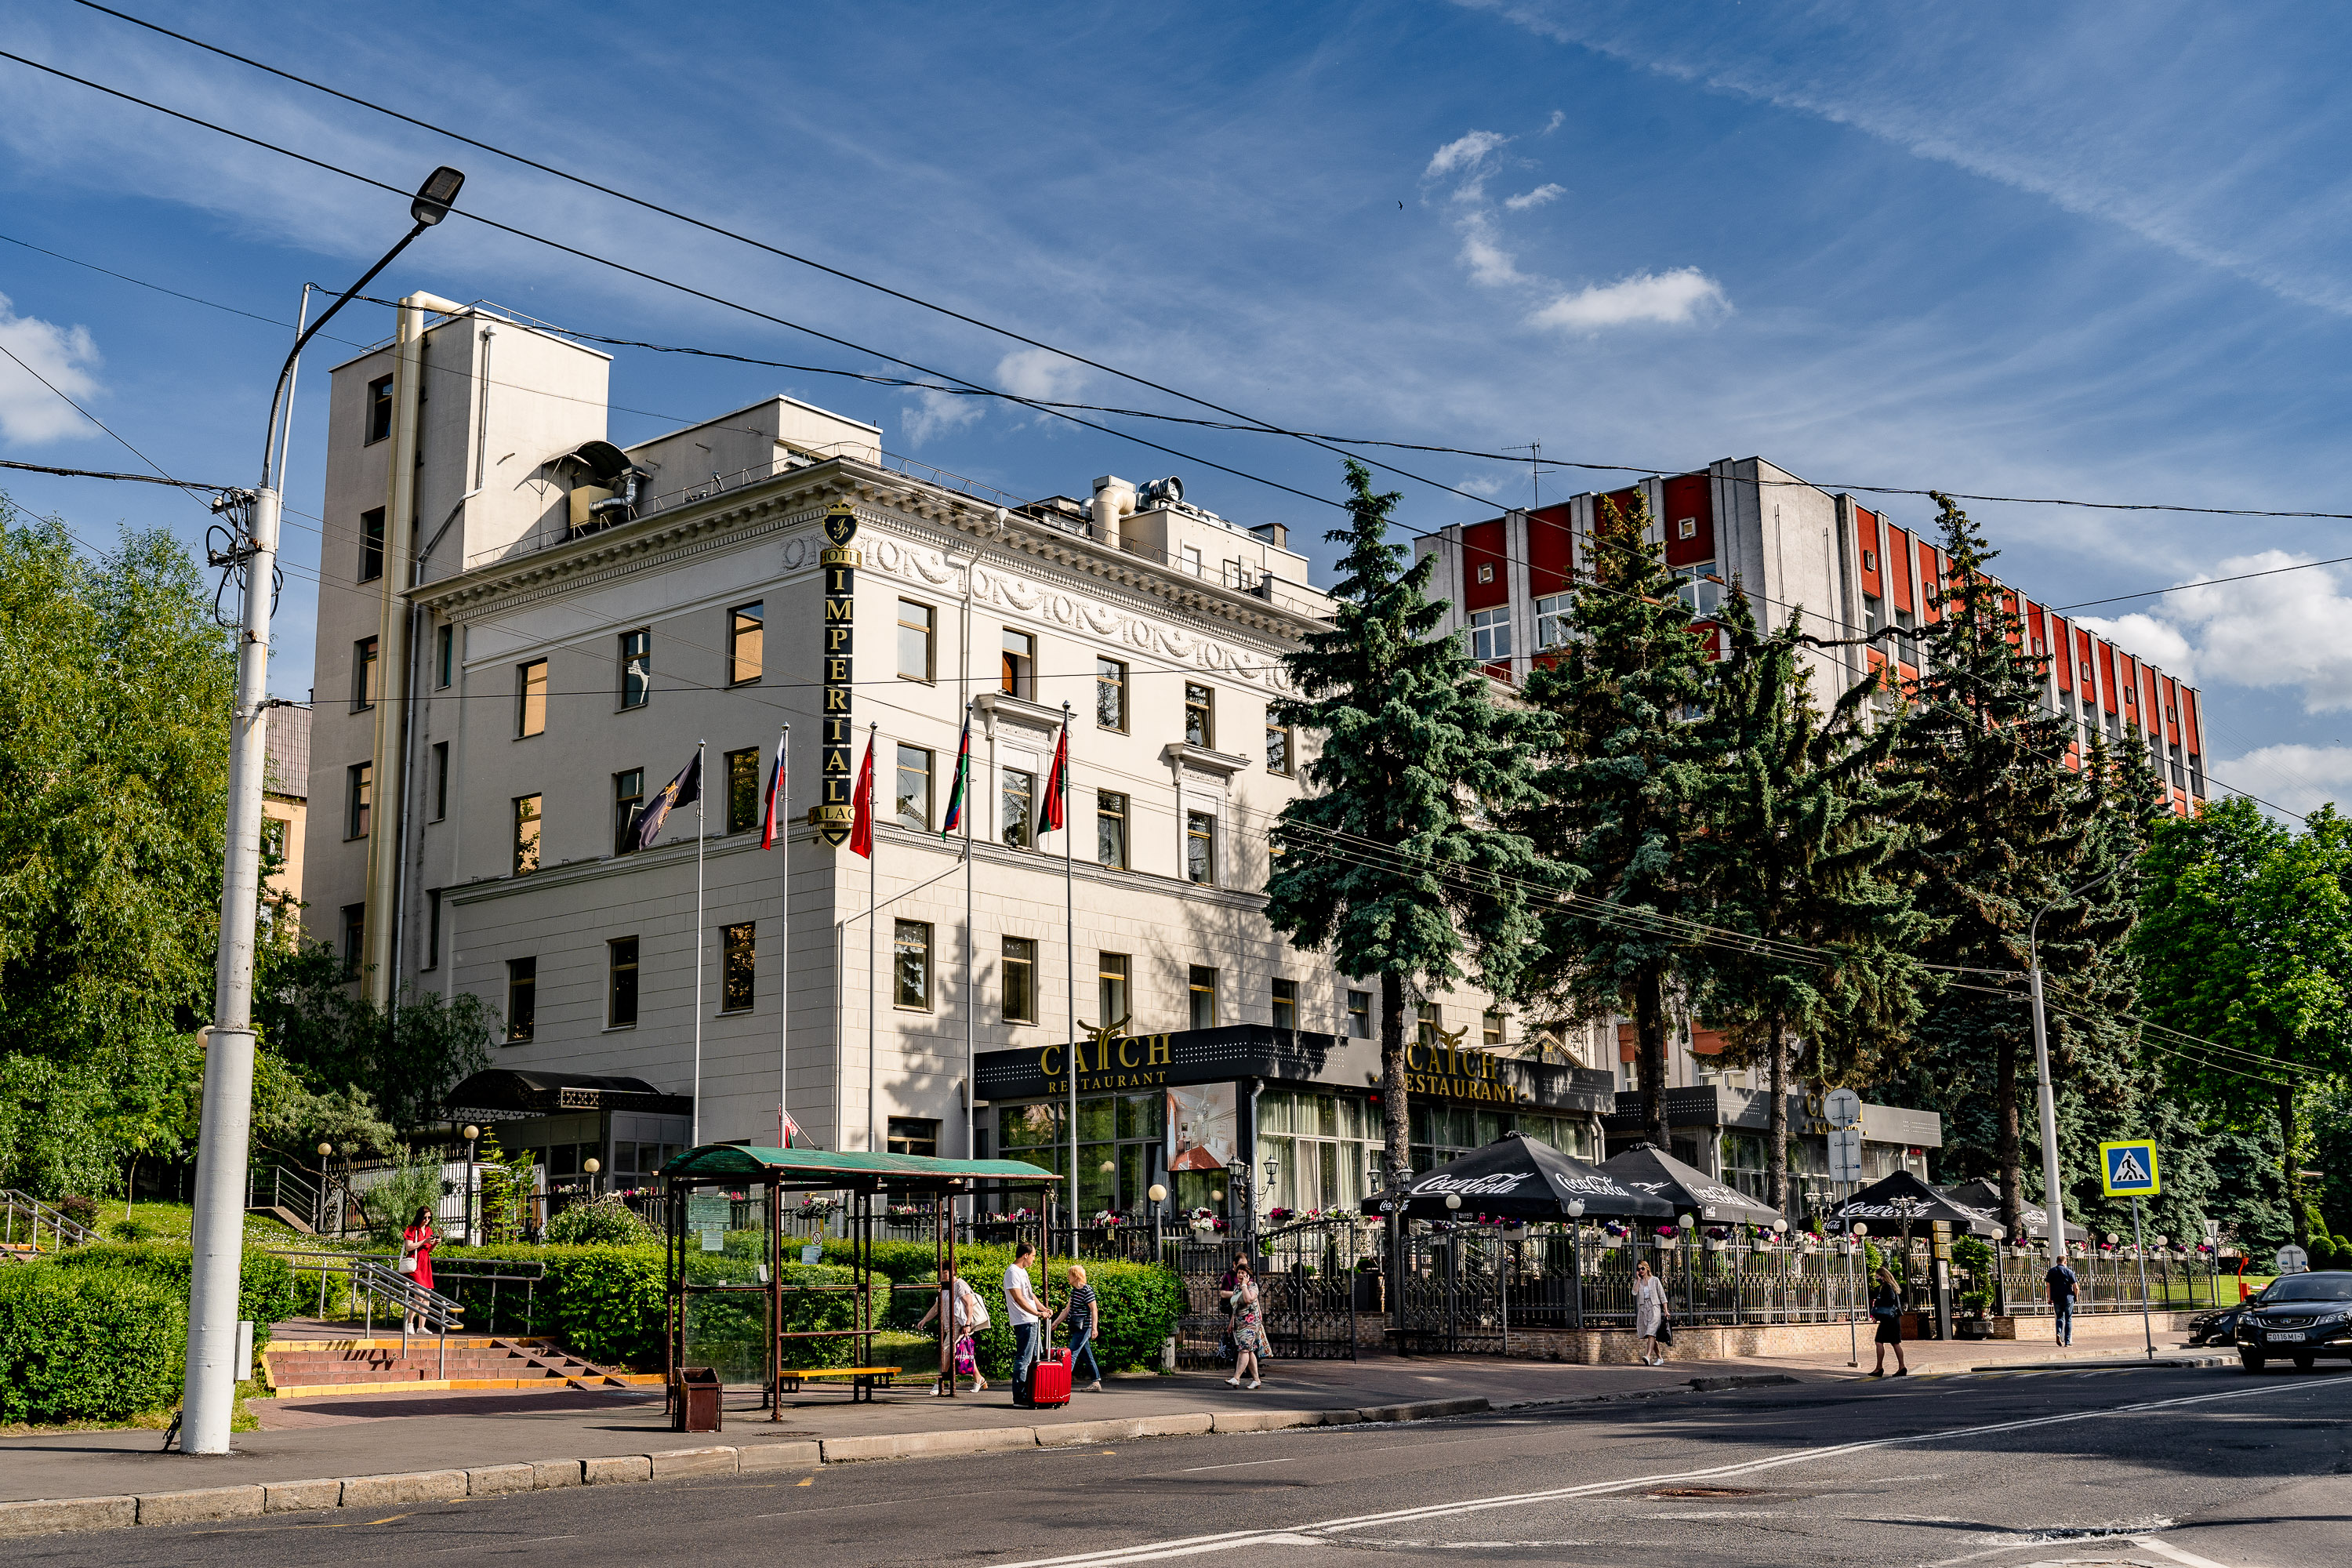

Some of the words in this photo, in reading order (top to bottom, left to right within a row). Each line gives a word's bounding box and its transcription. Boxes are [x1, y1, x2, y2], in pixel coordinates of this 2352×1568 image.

[821, 550, 861, 564] HOTEL
[826, 569, 853, 801] IMPERIAL
[808, 807, 855, 822] PALAC
[1405, 1021, 1497, 1080] CATCH
[1404, 1073, 1517, 1103] ESTAURANT
[1411, 1172, 1535, 1195] Coca-Cola
[1555, 1173, 1632, 1197] Coca-Cola
